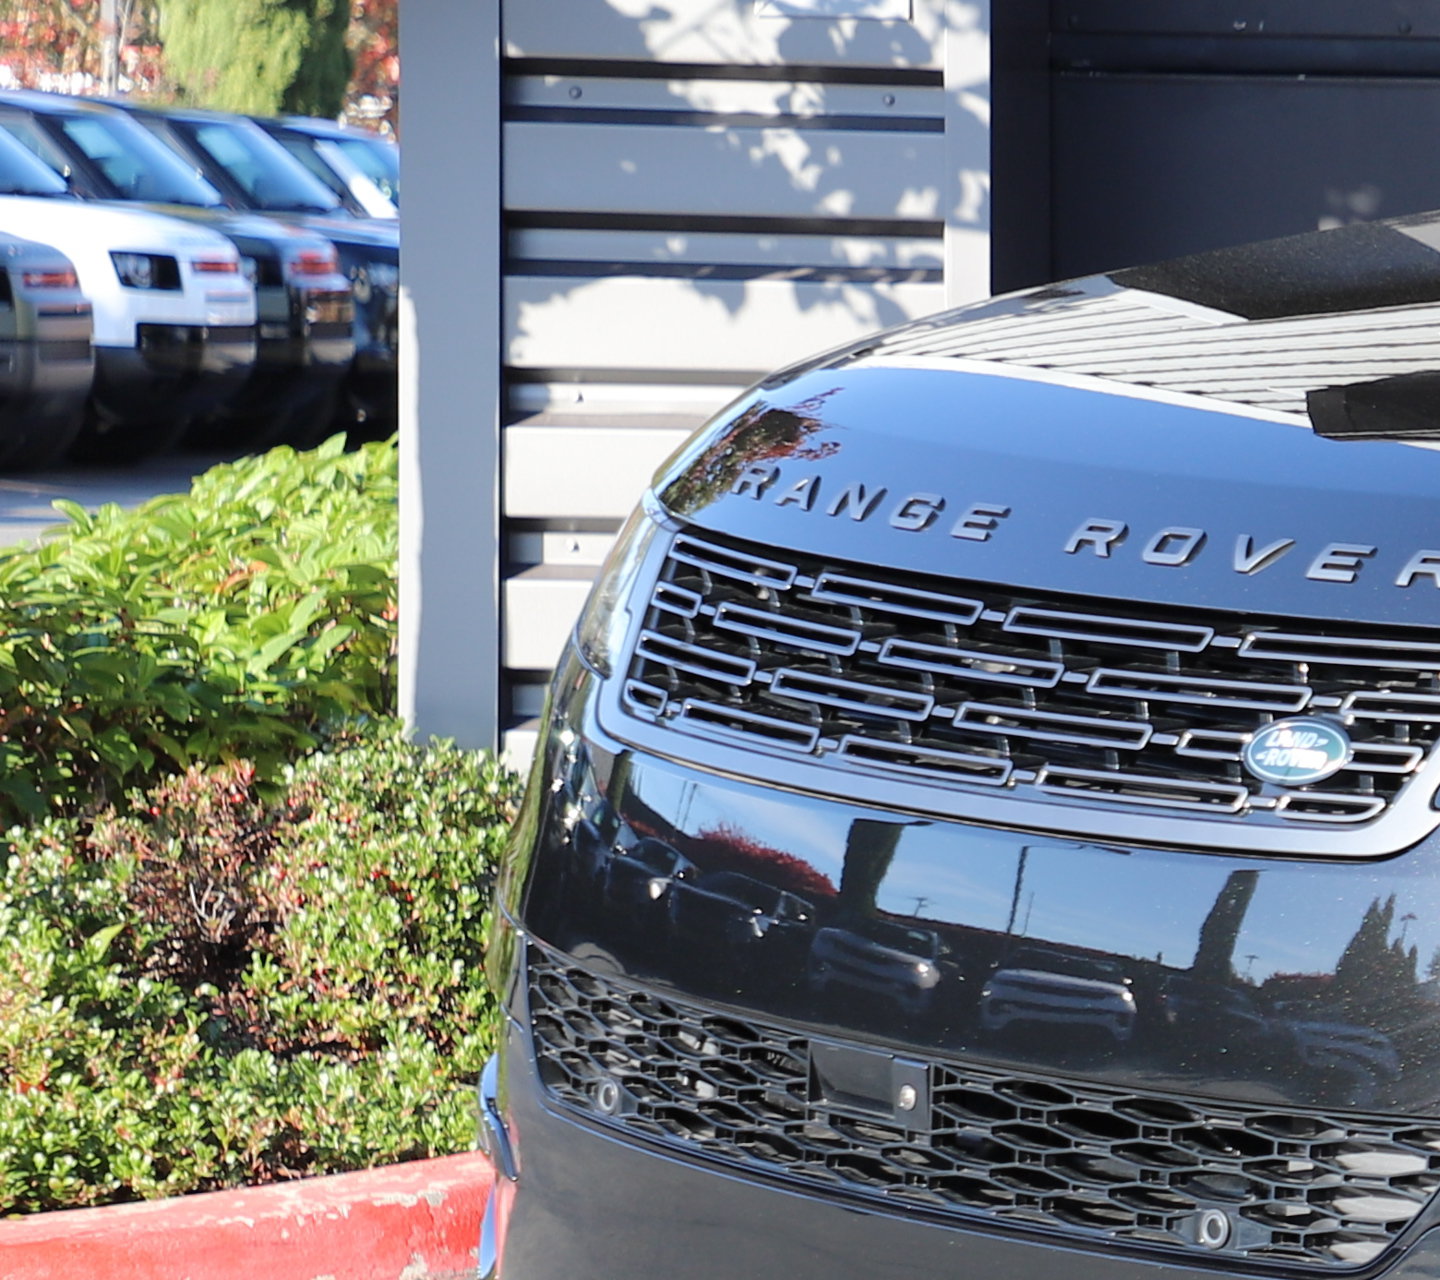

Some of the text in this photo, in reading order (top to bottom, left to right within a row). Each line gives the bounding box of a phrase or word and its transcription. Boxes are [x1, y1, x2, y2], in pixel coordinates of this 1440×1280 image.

[729, 461, 1012, 542] RANGE
[1265, 730, 1318, 748] LAND
[1263, 748, 1328, 770] ROV
